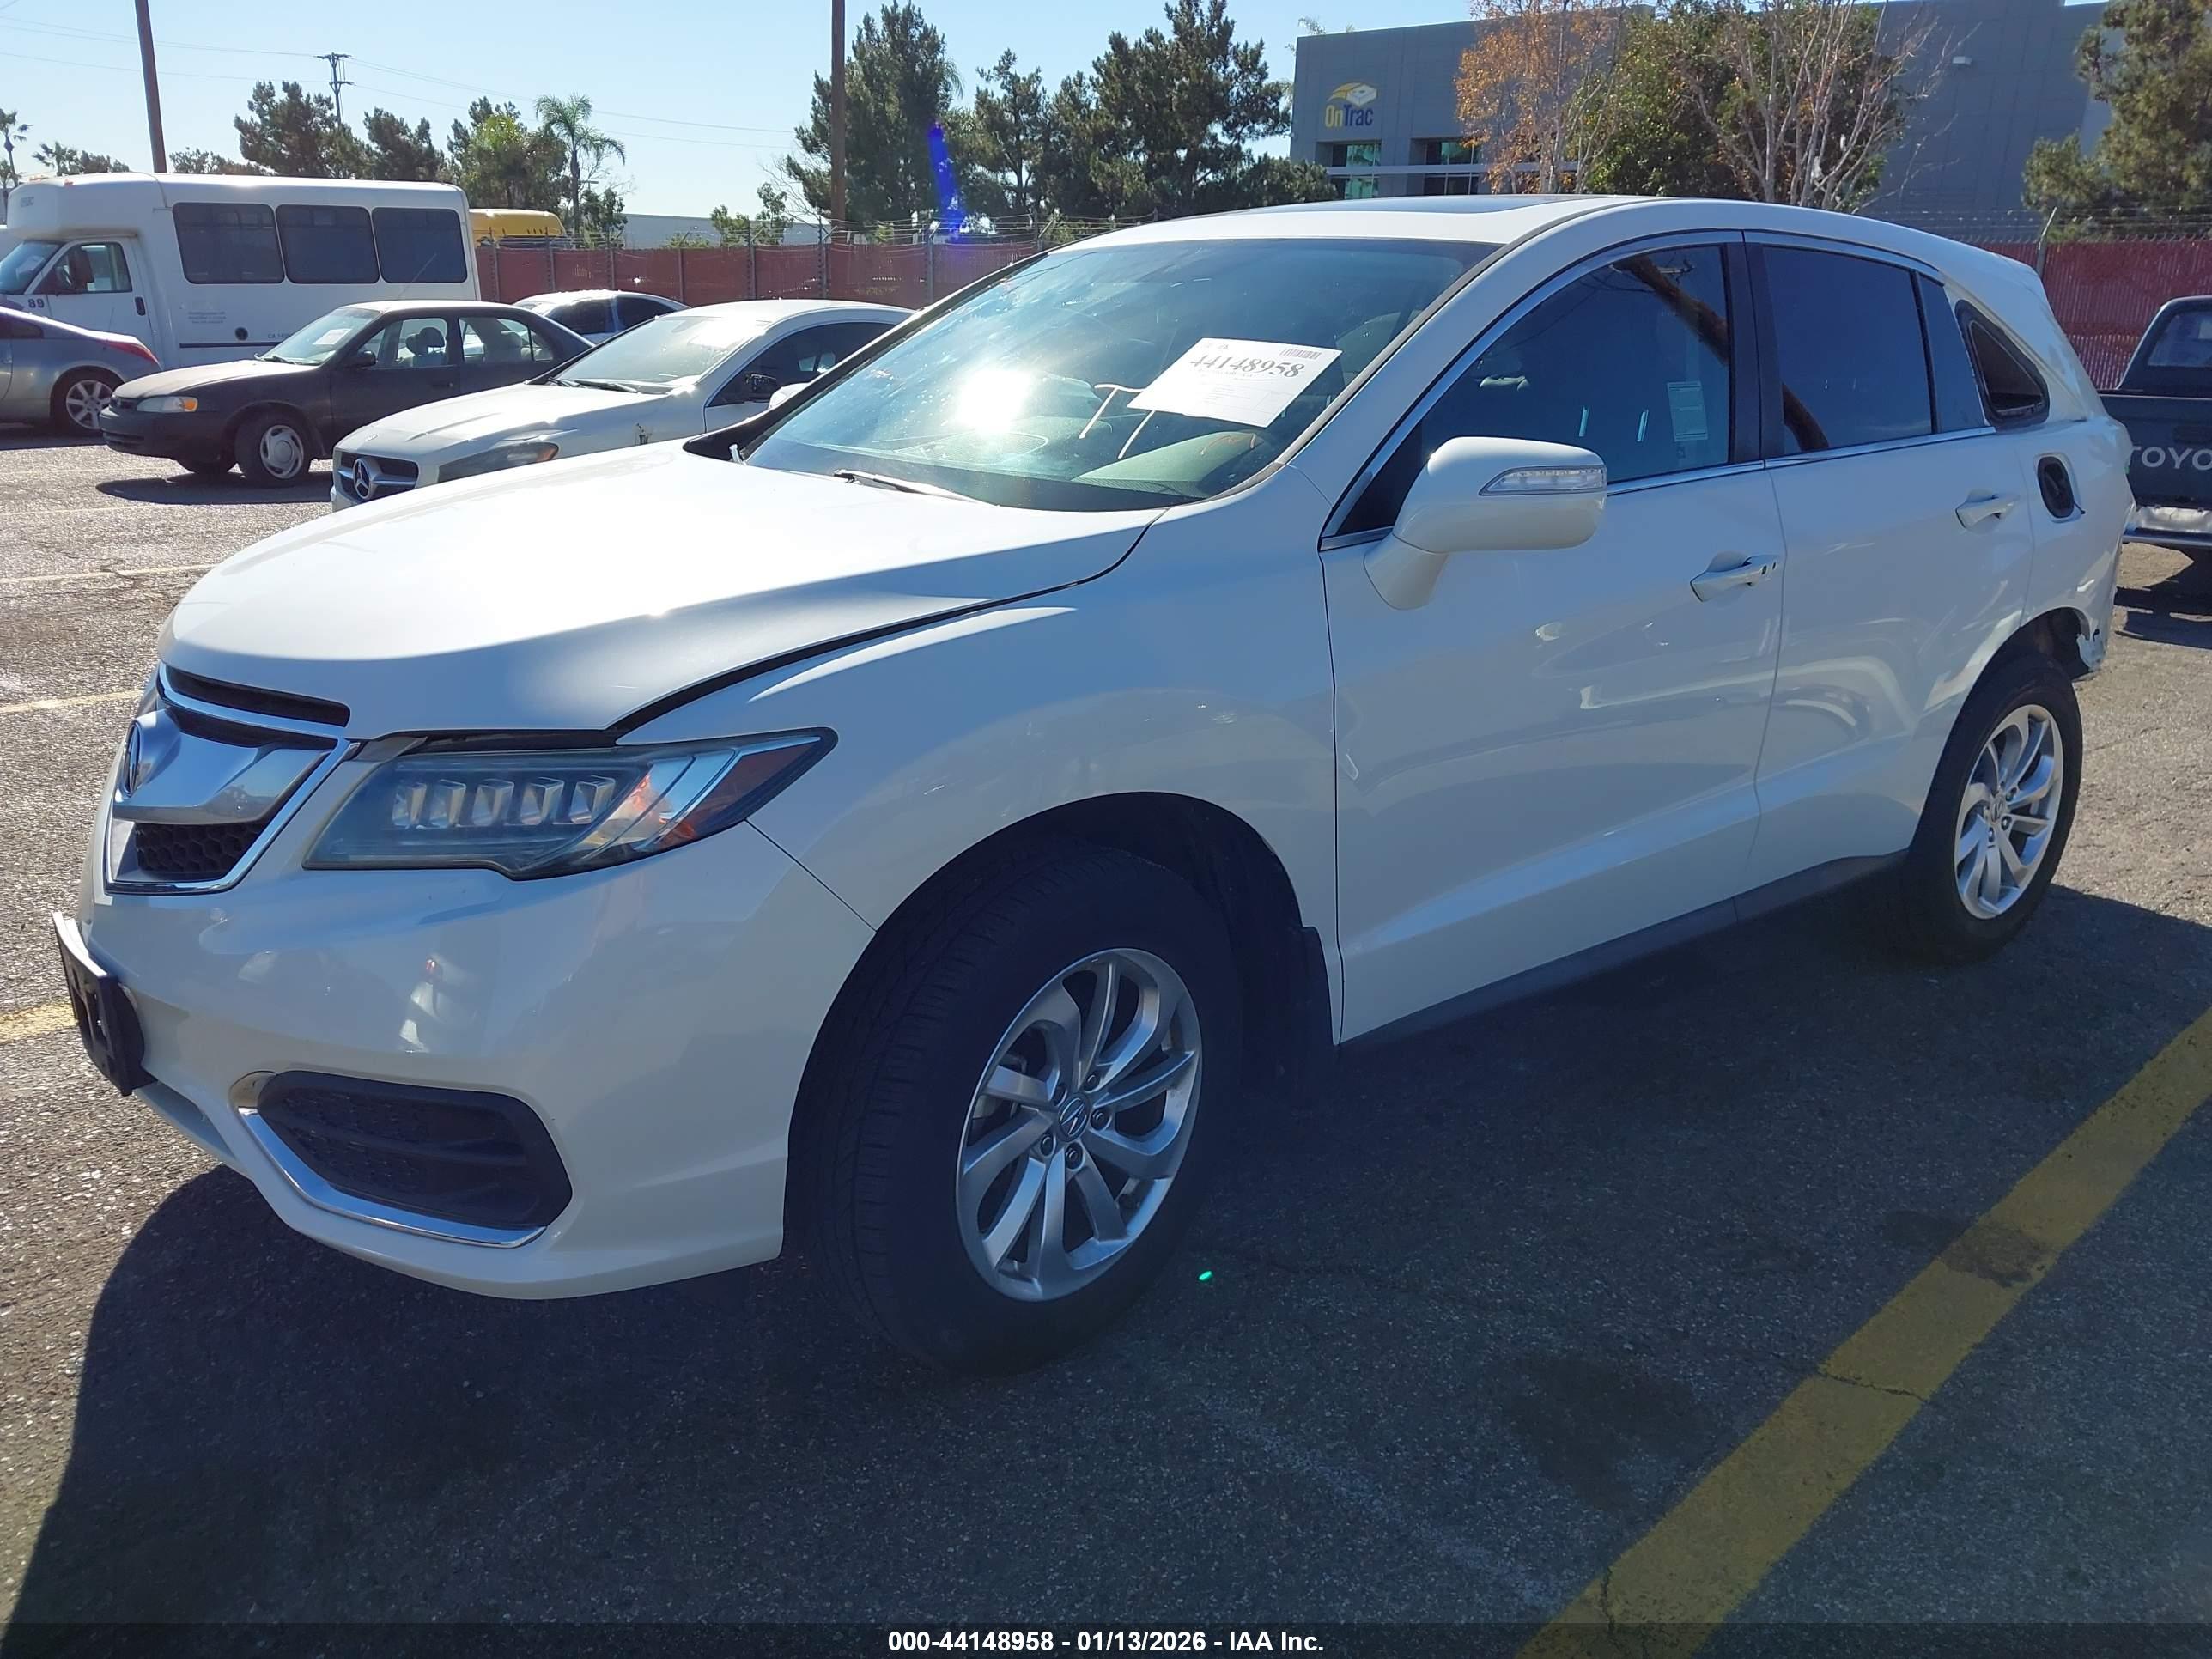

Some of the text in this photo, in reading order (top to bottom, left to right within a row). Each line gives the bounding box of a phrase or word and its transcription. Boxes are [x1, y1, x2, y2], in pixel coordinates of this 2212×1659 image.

[1325, 104, 1374, 128] OnTrac
[27, 298, 45, 308] 89
[1190, 354, 1305, 378] 44148958
